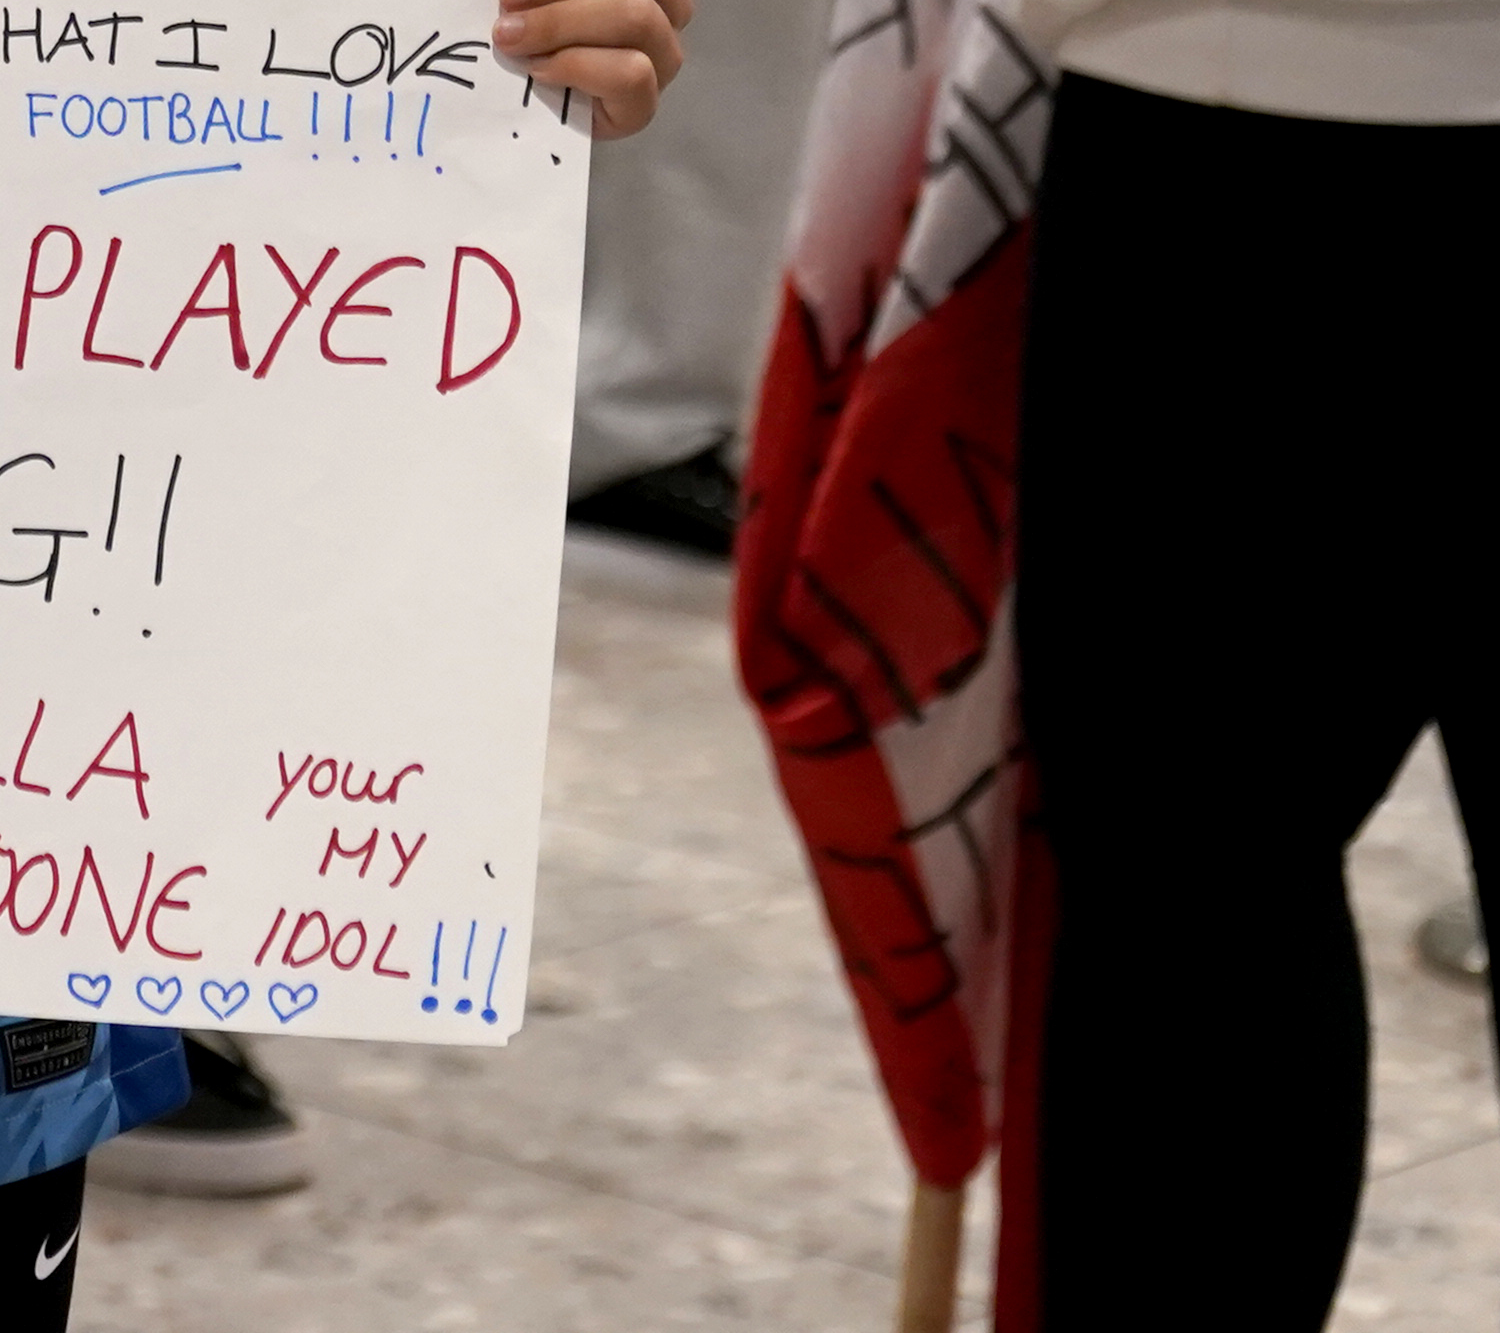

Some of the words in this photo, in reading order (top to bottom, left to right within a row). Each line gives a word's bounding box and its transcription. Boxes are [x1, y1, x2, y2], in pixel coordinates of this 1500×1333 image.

[155, 19, 227, 71] I
[15, 225, 521, 395] PLAYED
[266, 751, 424, 821] your
[319, 827, 426, 888] MY
